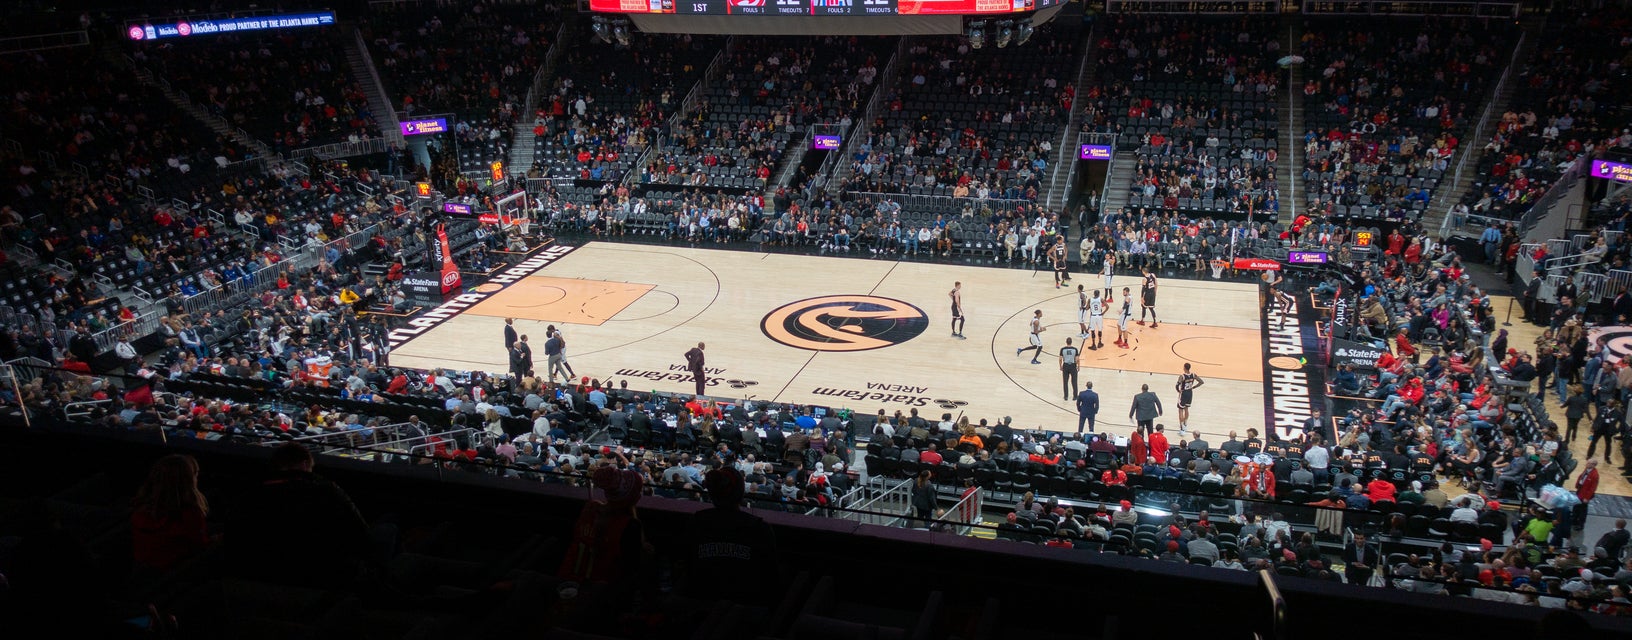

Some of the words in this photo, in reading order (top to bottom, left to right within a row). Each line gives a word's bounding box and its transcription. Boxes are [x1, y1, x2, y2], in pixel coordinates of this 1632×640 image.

[693, 3, 707, 12] 1ST
[191, 22, 218, 34] Modelo
[219, 22, 237, 32] PROUD
[237, 21, 261, 30] PARTNER
[261, 20, 269, 28] OF
[269, 20, 280, 28] THE
[280, 18, 302, 27] ATLANTA
[302, 17, 319, 26] HAWKS
[416, 121, 438, 130] planet
[491, 245, 575, 283] HAWKS
[411, 278, 439, 287] StateFarm
[1334, 298, 1346, 327] xfinity
[389, 292, 487, 347] TLANTA
[1348, 348, 1383, 359] StateFar
[669, 364, 727, 375] ARNA
[866, 382, 928, 394] ARENA
[812, 387, 932, 407] StateFarm
[1271, 369, 1311, 444] HAWKS
